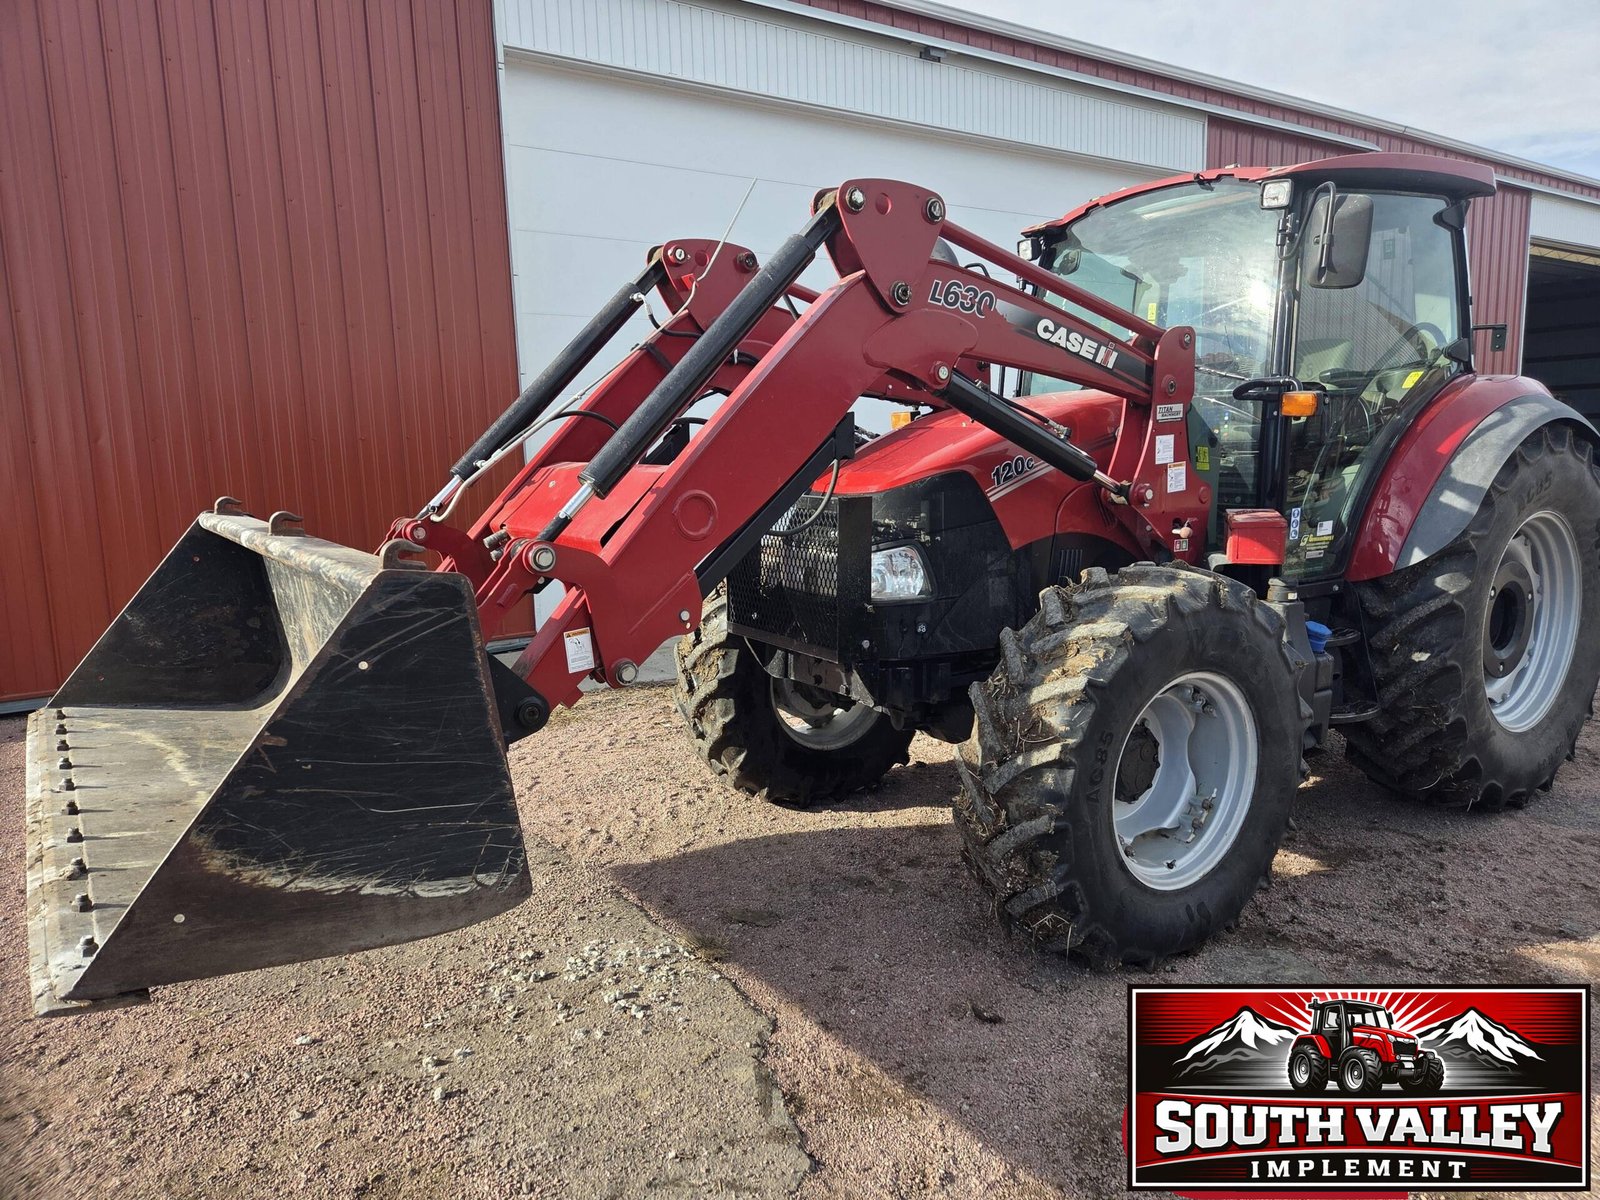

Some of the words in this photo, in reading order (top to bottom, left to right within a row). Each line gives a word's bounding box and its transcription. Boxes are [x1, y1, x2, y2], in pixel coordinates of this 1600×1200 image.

[928, 279, 997, 319] L630
[1036, 318, 1098, 360] CASE
[1158, 405, 1174, 414] TITAN
